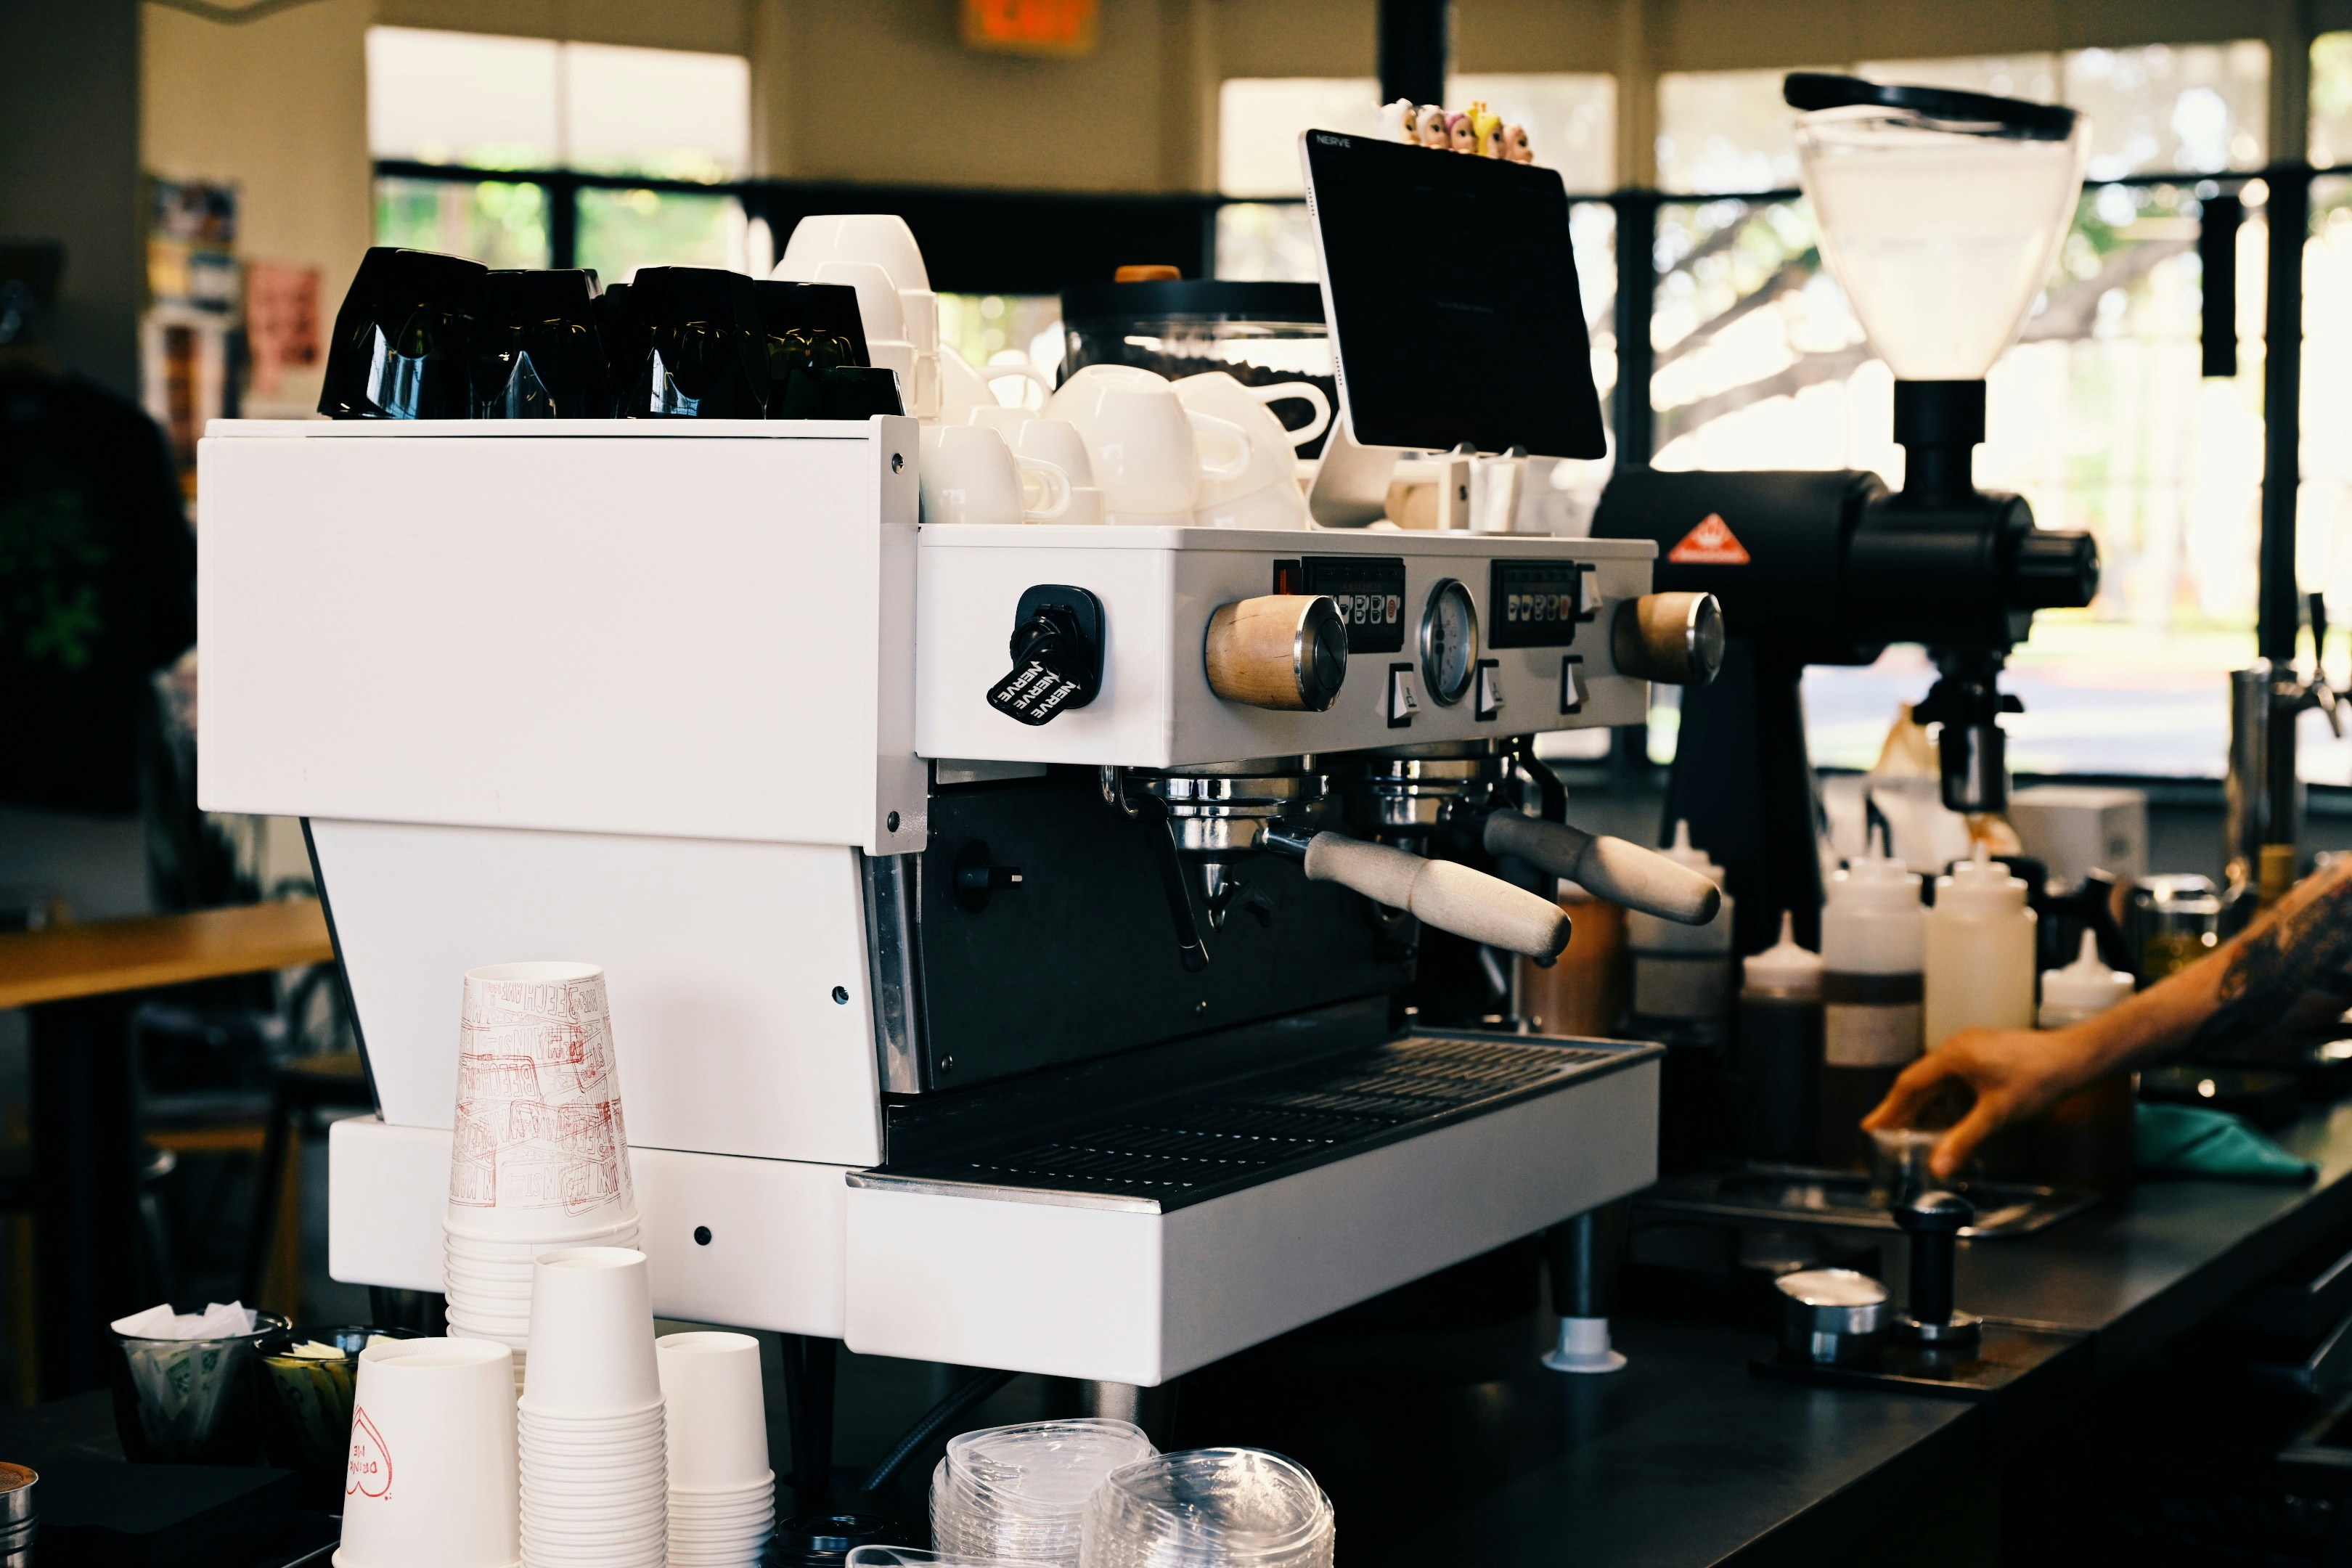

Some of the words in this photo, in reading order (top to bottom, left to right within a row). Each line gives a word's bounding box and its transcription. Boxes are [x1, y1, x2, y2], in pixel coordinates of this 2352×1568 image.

[1317, 134, 1351, 147] NERVE
[997, 661, 1044, 703] NERVE
[1013, 672, 1060, 709] NERVE
[1030, 680, 1077, 719] NERVE
[481, 1063, 536, 1098] BEECH
[350, 1461, 377, 1474] DRINK
[354, 1445, 365, 1458] ME
